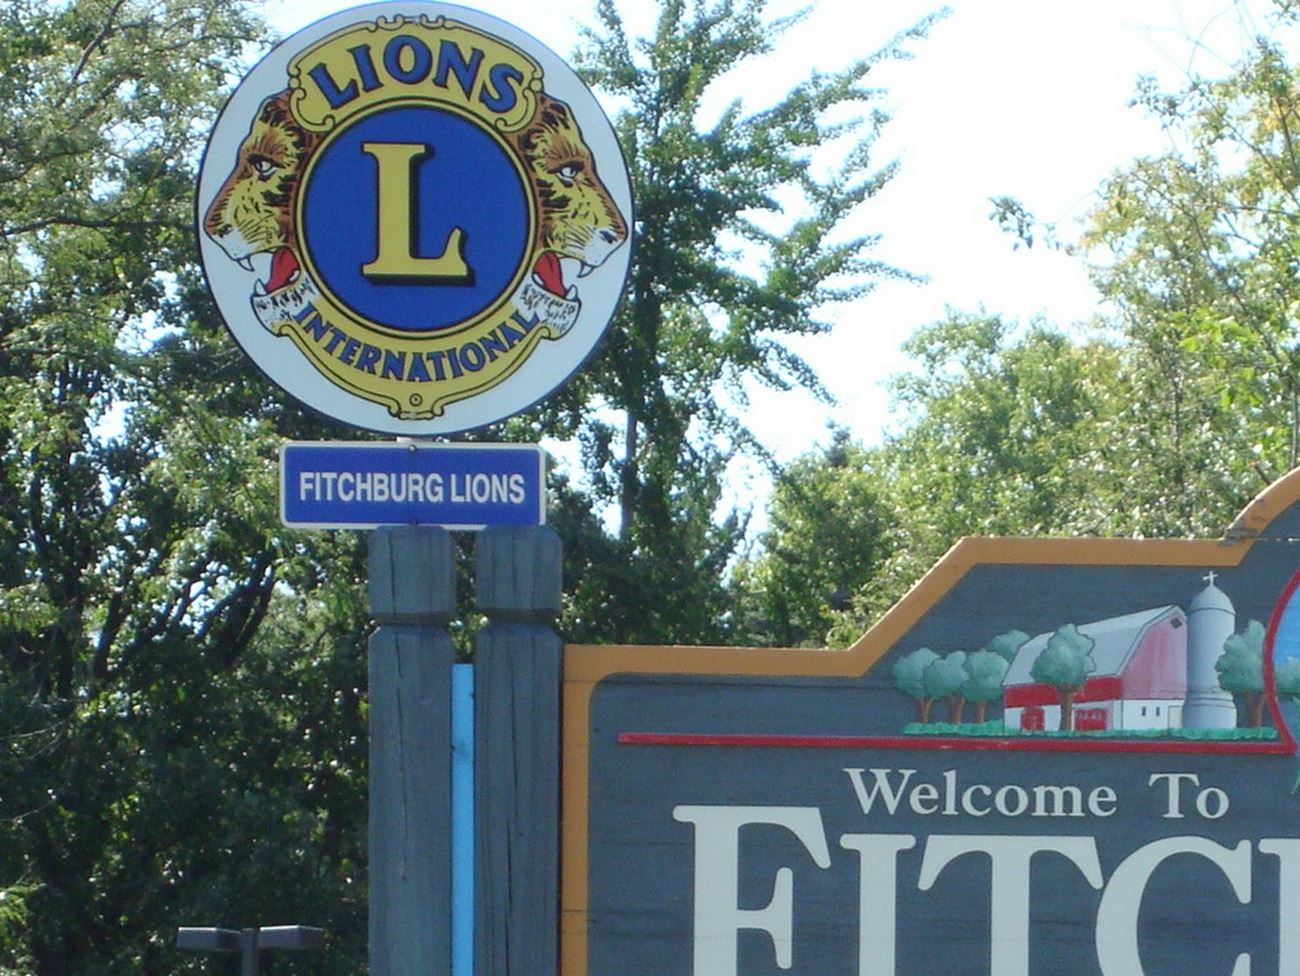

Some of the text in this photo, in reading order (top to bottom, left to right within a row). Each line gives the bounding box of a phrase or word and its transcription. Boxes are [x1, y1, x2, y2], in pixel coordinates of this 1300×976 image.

[308, 36, 524, 113] LIONS
[361, 142, 475, 286] L
[295, 301, 540, 383] INTERNATIONAL
[299, 472, 525, 504] FITCHBURG LIONS
[843, 767, 1230, 819] Welcome To
